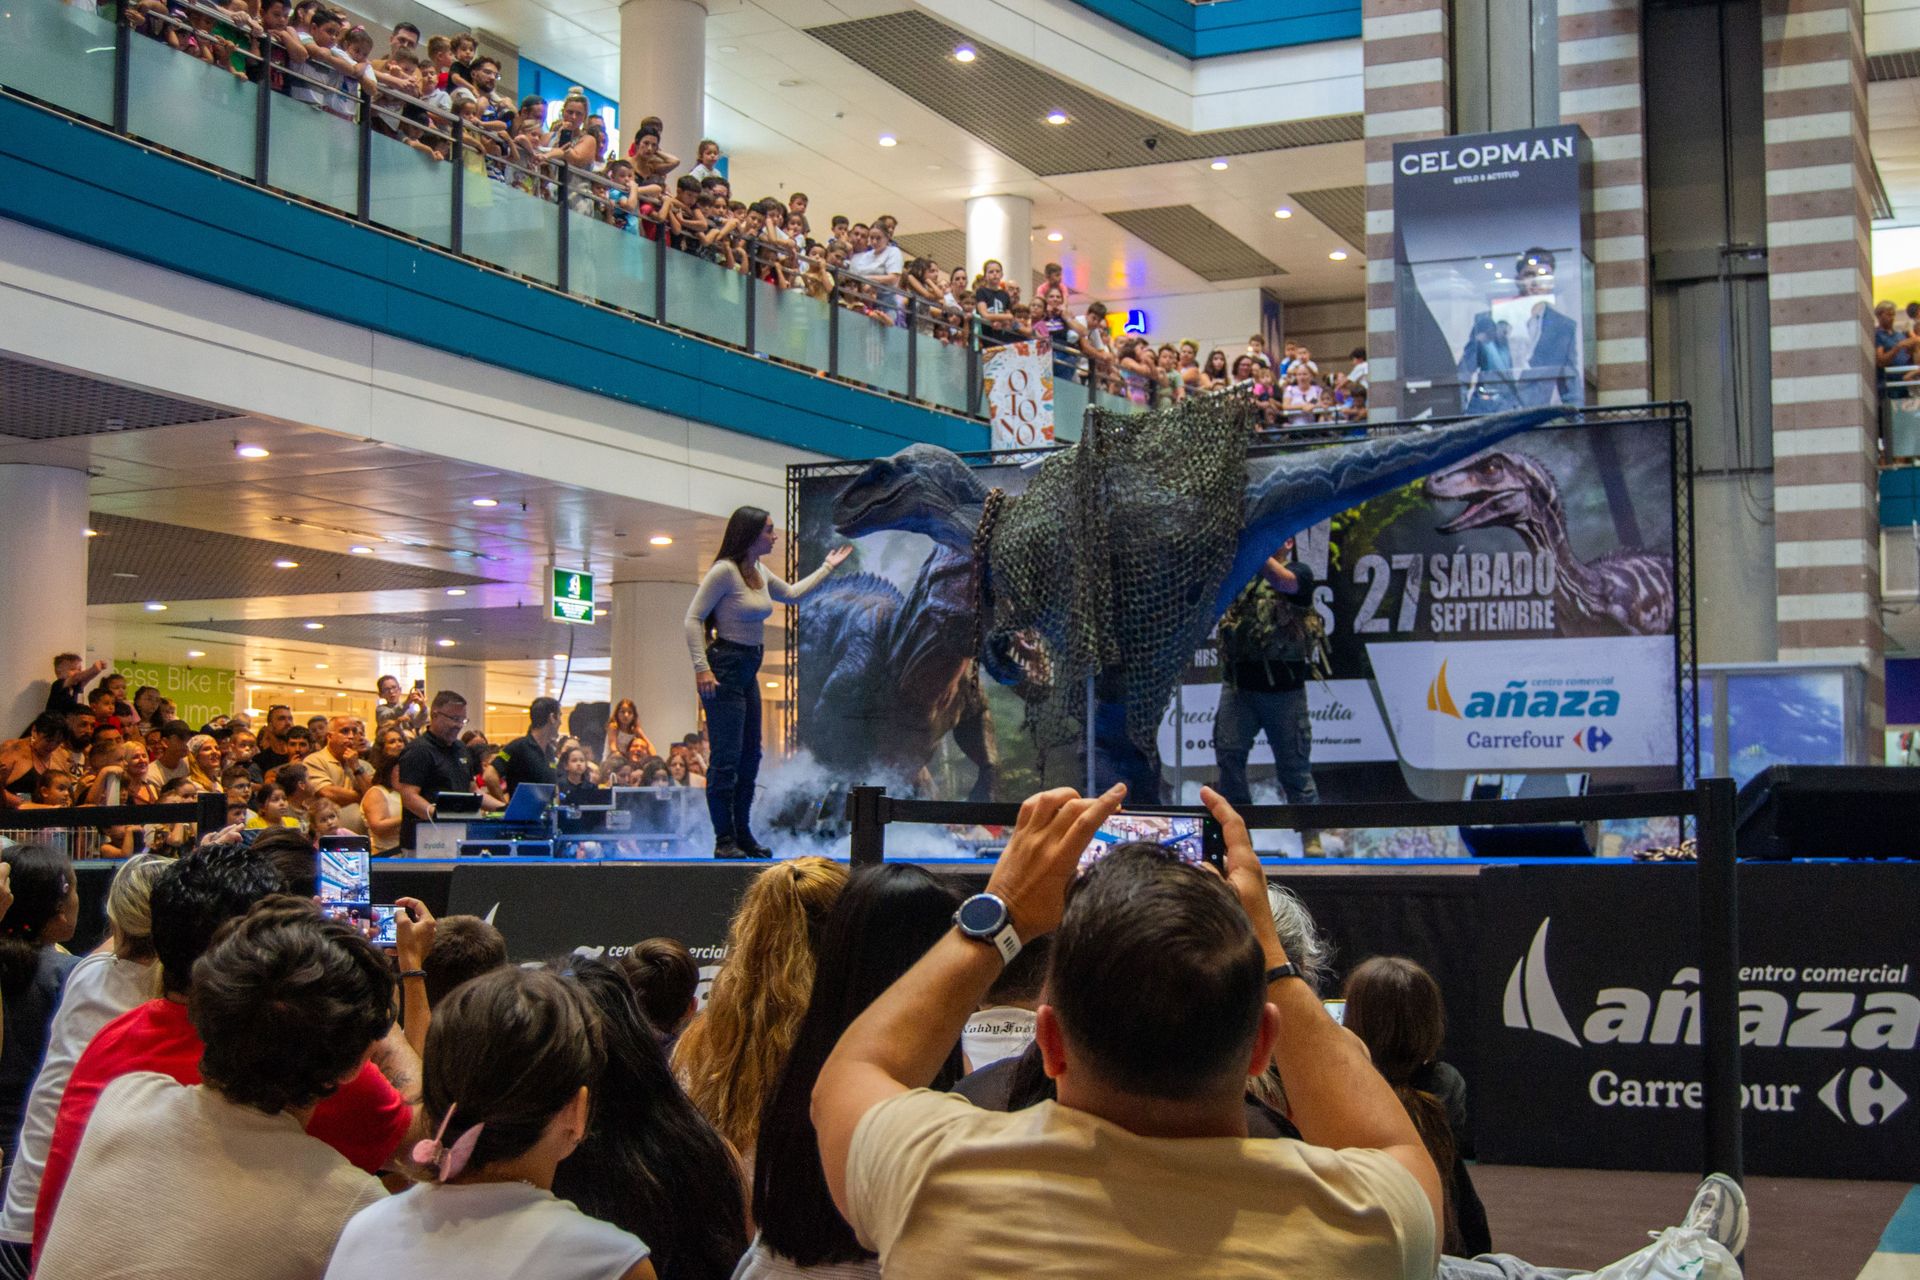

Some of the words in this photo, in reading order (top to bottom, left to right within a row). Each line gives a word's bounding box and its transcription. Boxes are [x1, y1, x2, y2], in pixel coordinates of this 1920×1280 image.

[1400, 136, 1574, 175] CELOPMAN
[1353, 553, 1423, 634] 27
[1430, 545, 1556, 600] SÁBADO
[1430, 599, 1555, 633] SEPTIEMBRE
[168, 667, 211, 692] Bike
[1464, 680, 1621, 718] añaza
[1467, 730, 1564, 749] Carrefour
[1738, 965, 1796, 983] entro
[1801, 964, 1909, 984] comercial
